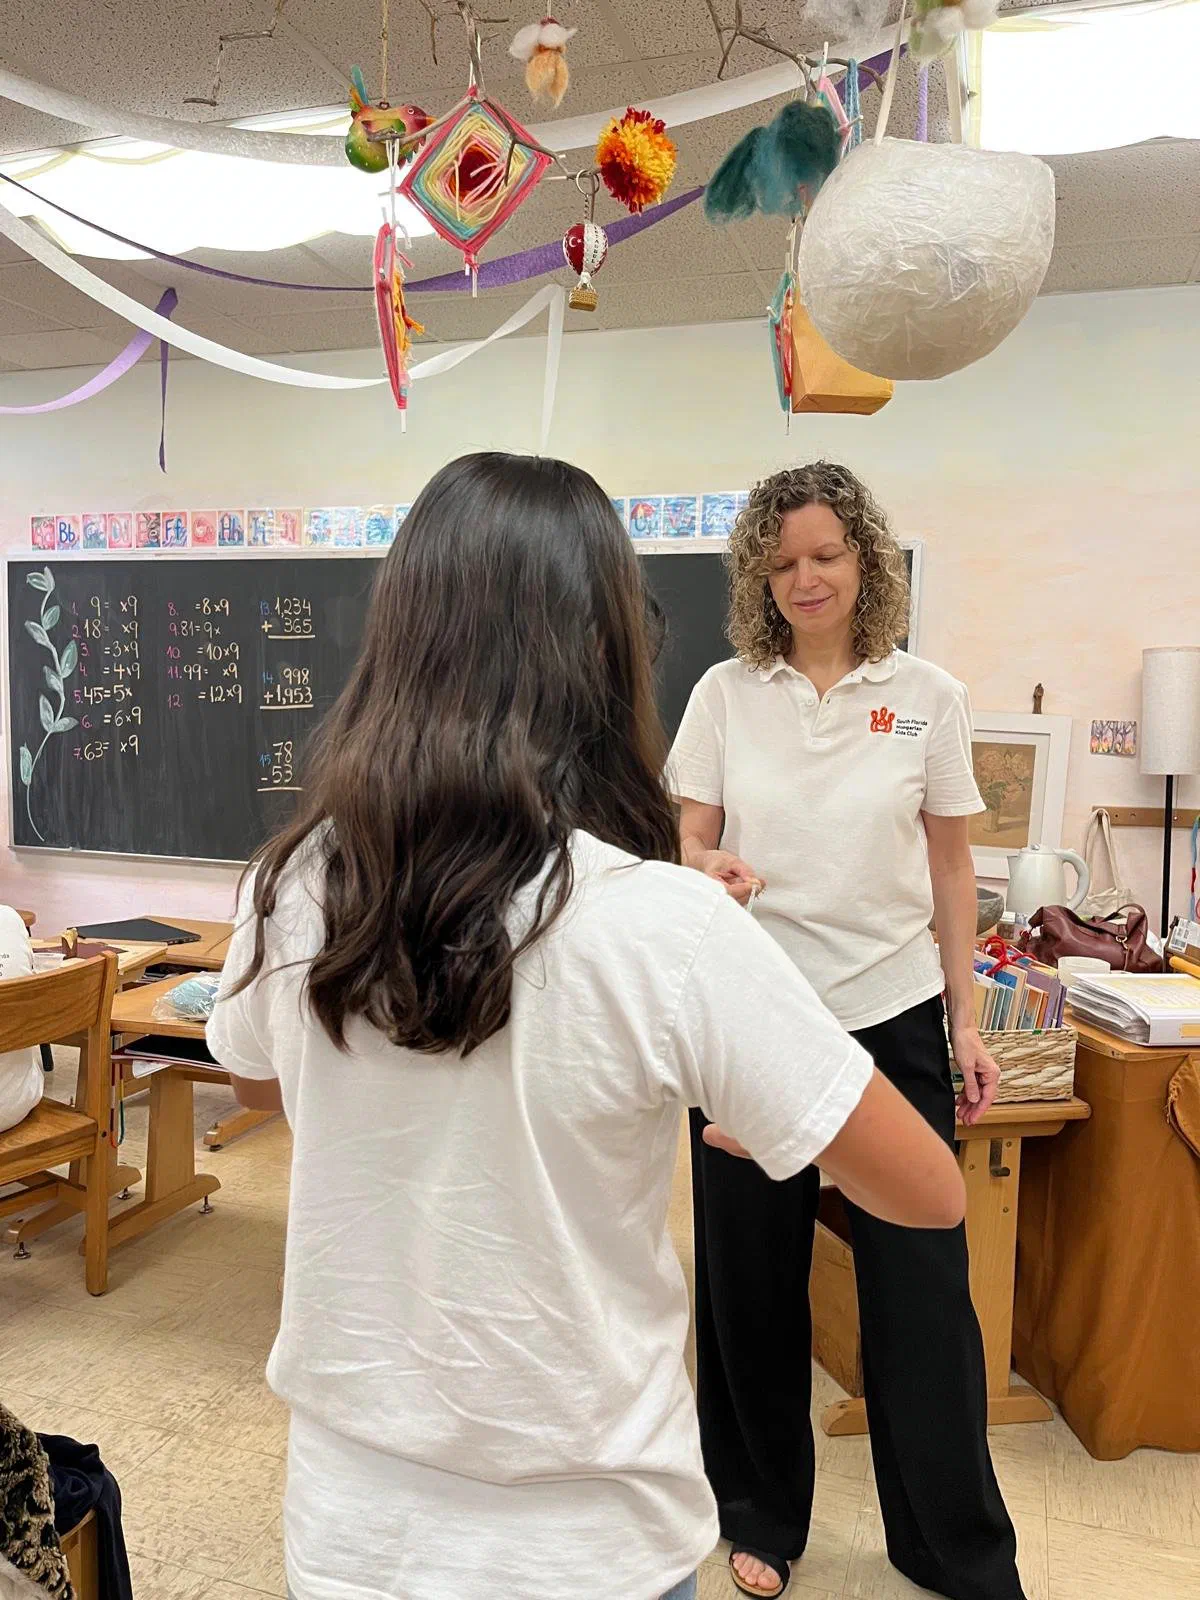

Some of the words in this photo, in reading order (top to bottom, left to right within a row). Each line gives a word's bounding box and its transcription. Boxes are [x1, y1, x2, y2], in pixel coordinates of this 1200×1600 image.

[59, 521, 76, 544] Bb
[165, 518, 182, 541] Ff
[221, 513, 243, 541] Hh
[274, 596, 312, 619] 1,234
[284, 618, 313, 635] 365
[283, 668, 310, 686] 998
[272, 741, 294, 764] 78
